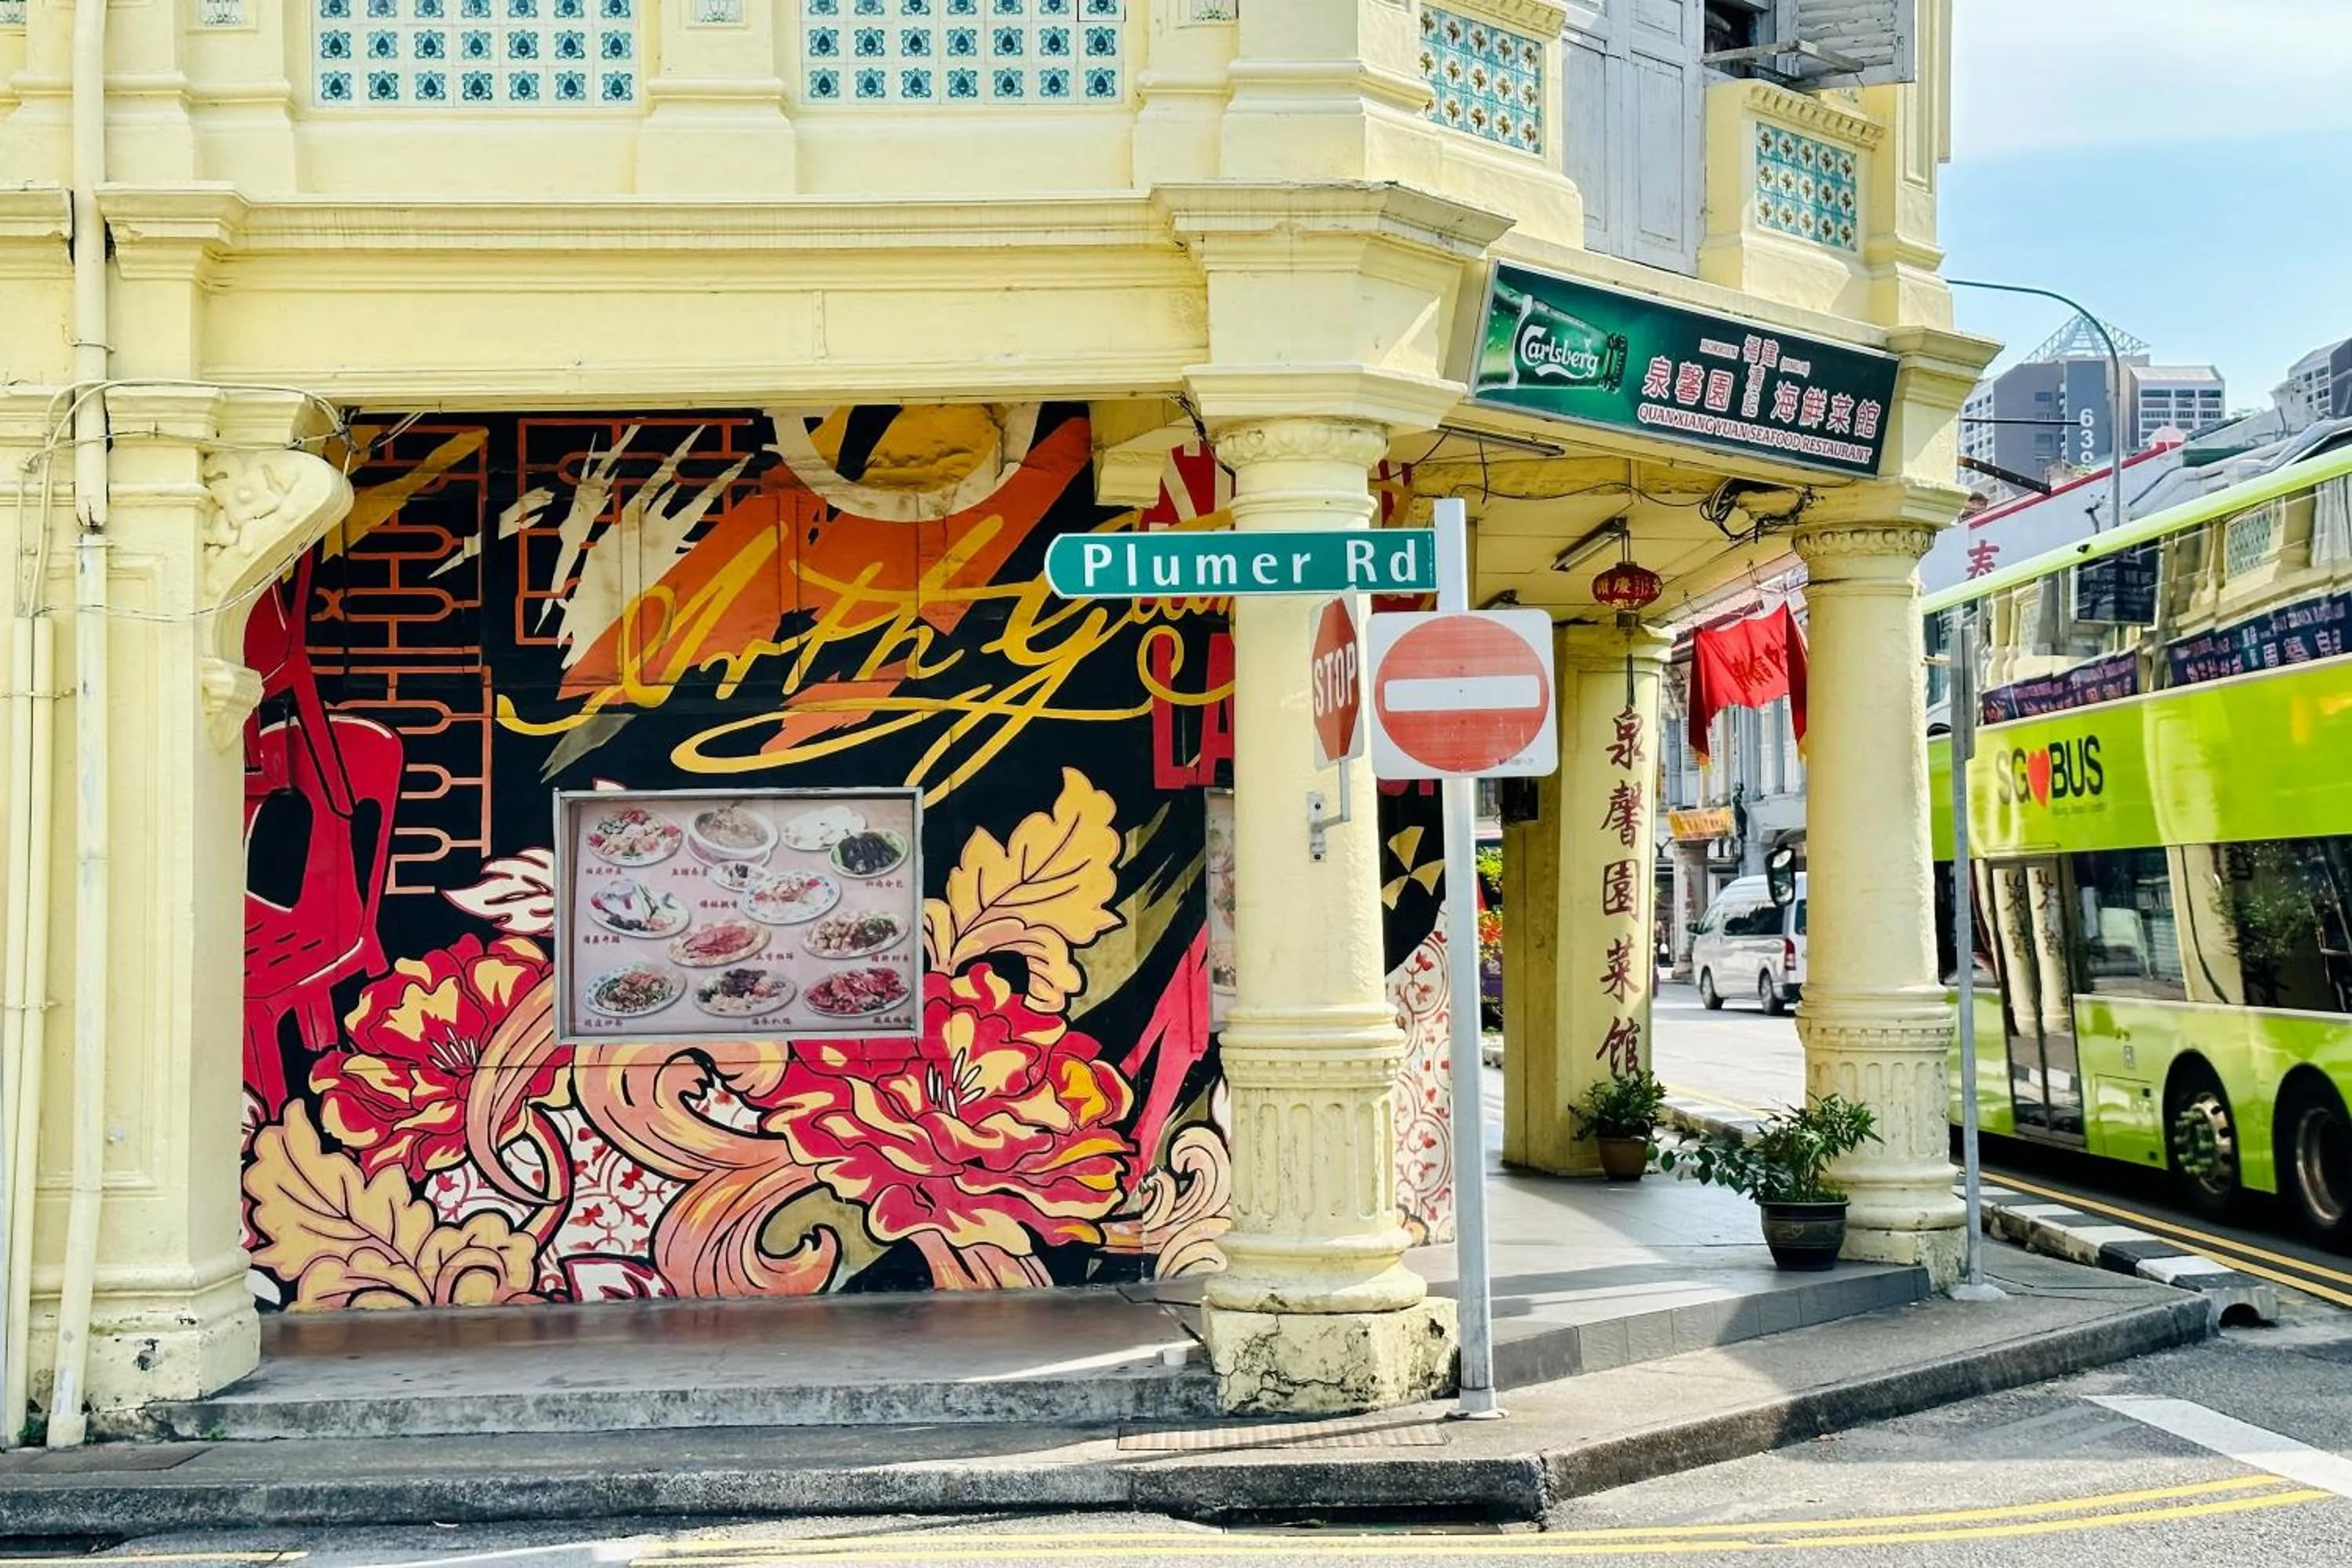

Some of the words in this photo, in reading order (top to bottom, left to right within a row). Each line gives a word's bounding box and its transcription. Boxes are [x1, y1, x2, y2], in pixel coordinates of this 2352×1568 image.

[1521, 324, 1599, 377] Carlsberg
[1642, 356, 1733, 411] 泉馨園
[1639, 405, 1674, 426] QUAN
[1675, 410, 1714, 433] XIANG
[1715, 418, 1748, 439] YUAN
[1750, 426, 1801, 448] SEAFOOD
[1802, 436, 1871, 462] RESTAURANT
[1083, 543, 1310, 586] Plumer
[1346, 538, 1417, 583] Rd
[1314, 641, 1356, 717] STOP
[2049, 735, 2103, 798] BUS
